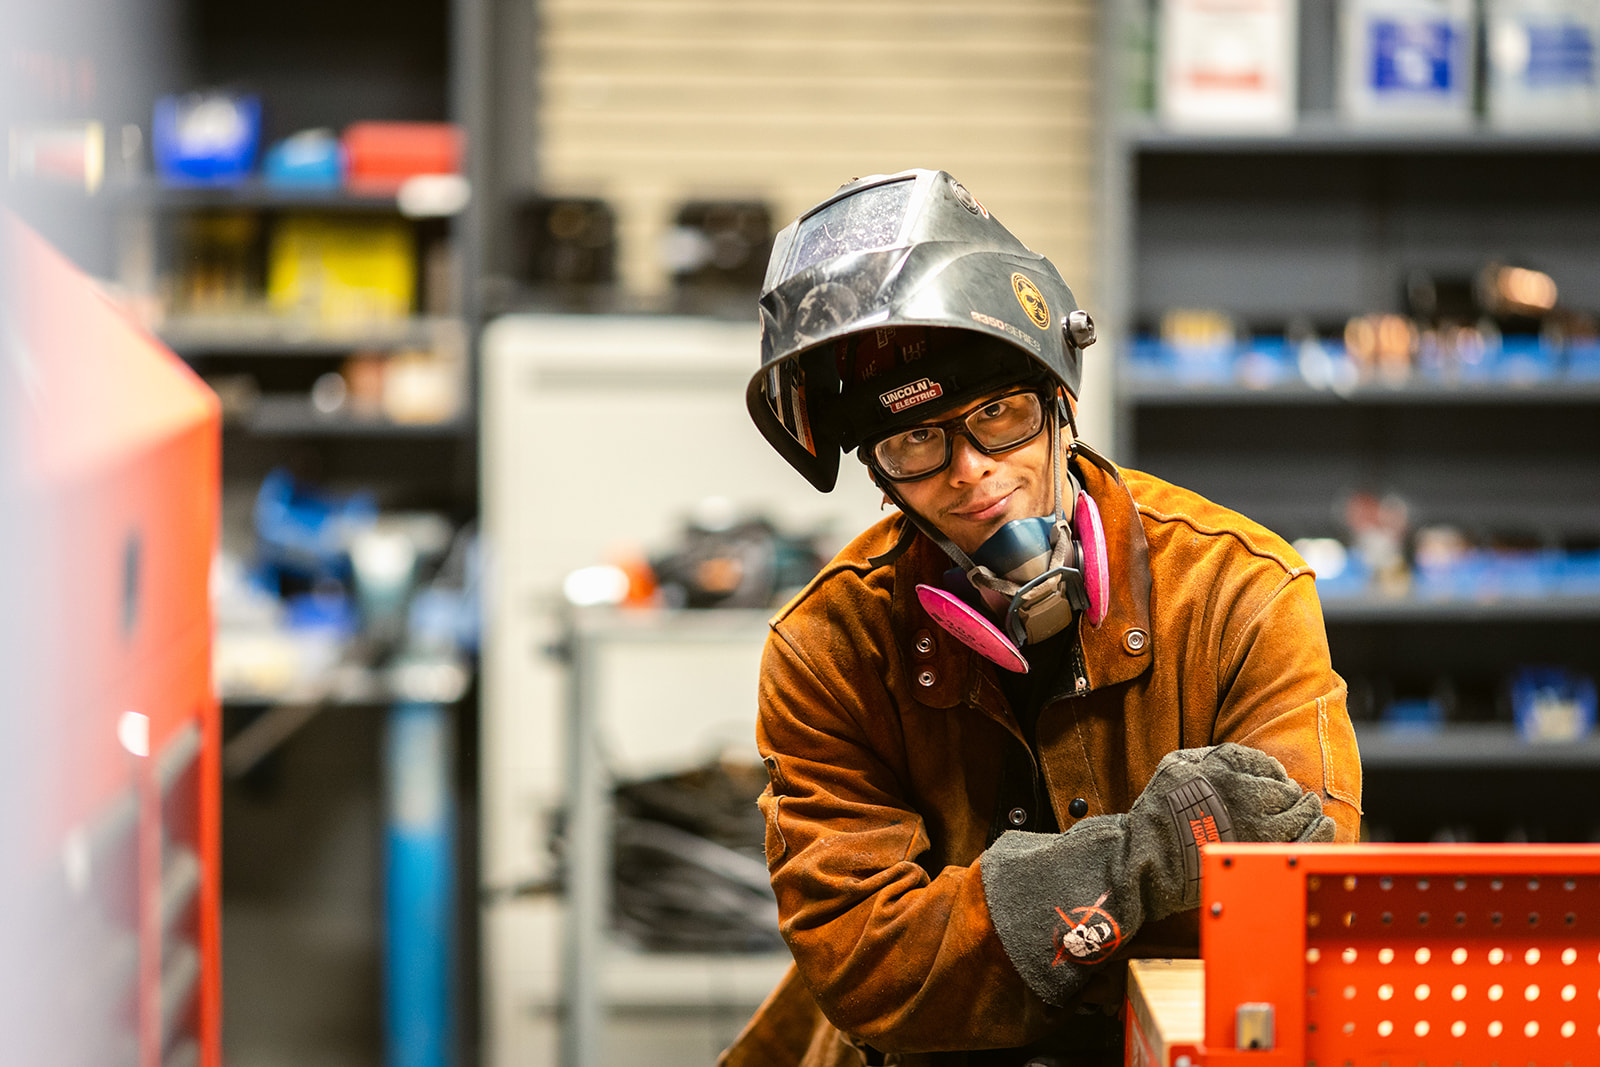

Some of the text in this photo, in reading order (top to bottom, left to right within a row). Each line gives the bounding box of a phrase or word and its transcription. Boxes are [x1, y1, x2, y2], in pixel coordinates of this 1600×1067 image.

[882, 381, 928, 405] LINCOLN
[895, 389, 937, 410] ELECTRIC
[1190, 819, 1208, 851] RCHY
[1202, 816, 1221, 842] DING
